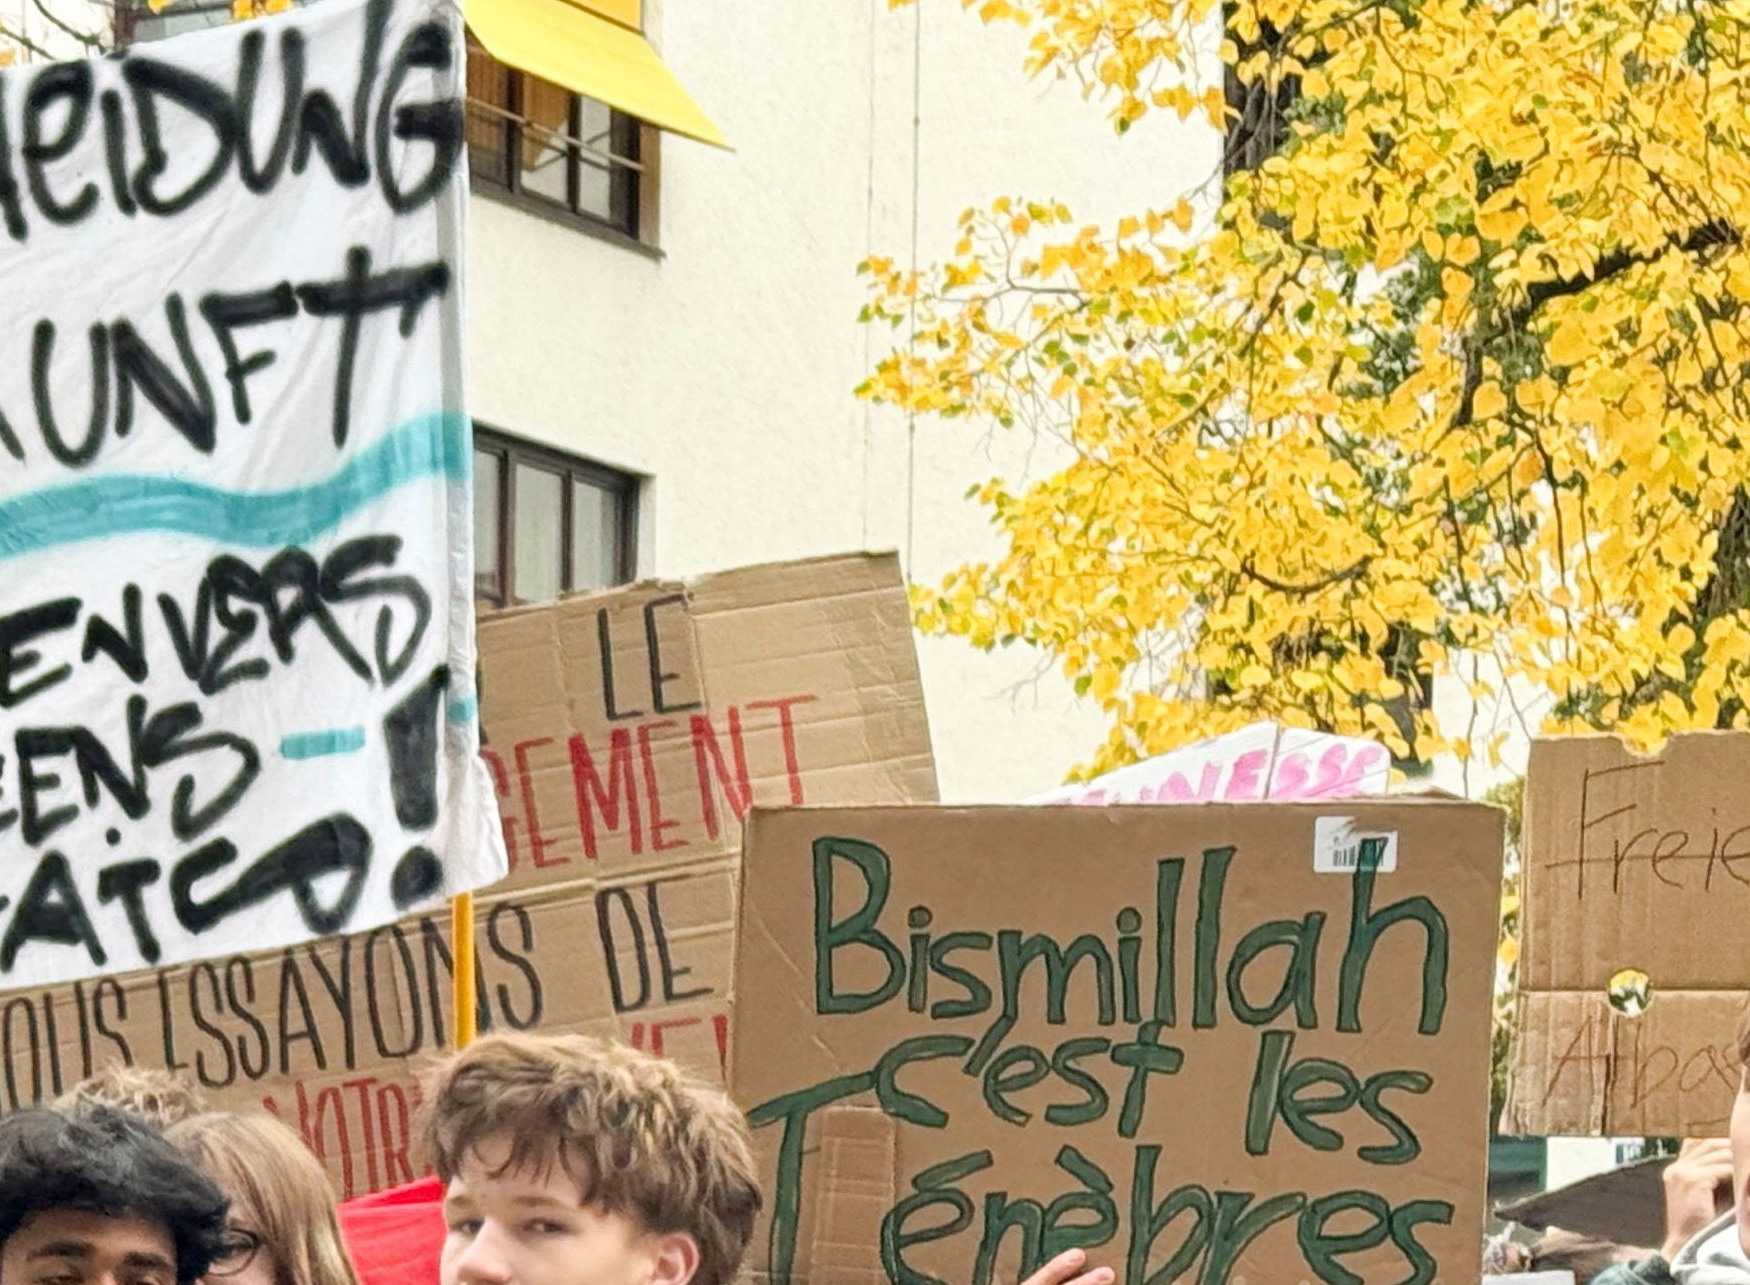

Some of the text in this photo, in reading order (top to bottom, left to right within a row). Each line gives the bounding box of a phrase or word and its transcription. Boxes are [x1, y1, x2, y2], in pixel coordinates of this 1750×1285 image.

[597, 593, 702, 722] LE
[595, 873, 714, 1012] DE
[812, 836, 1449, 1034] Bismillah
[1245, 1031, 1434, 1166] les
